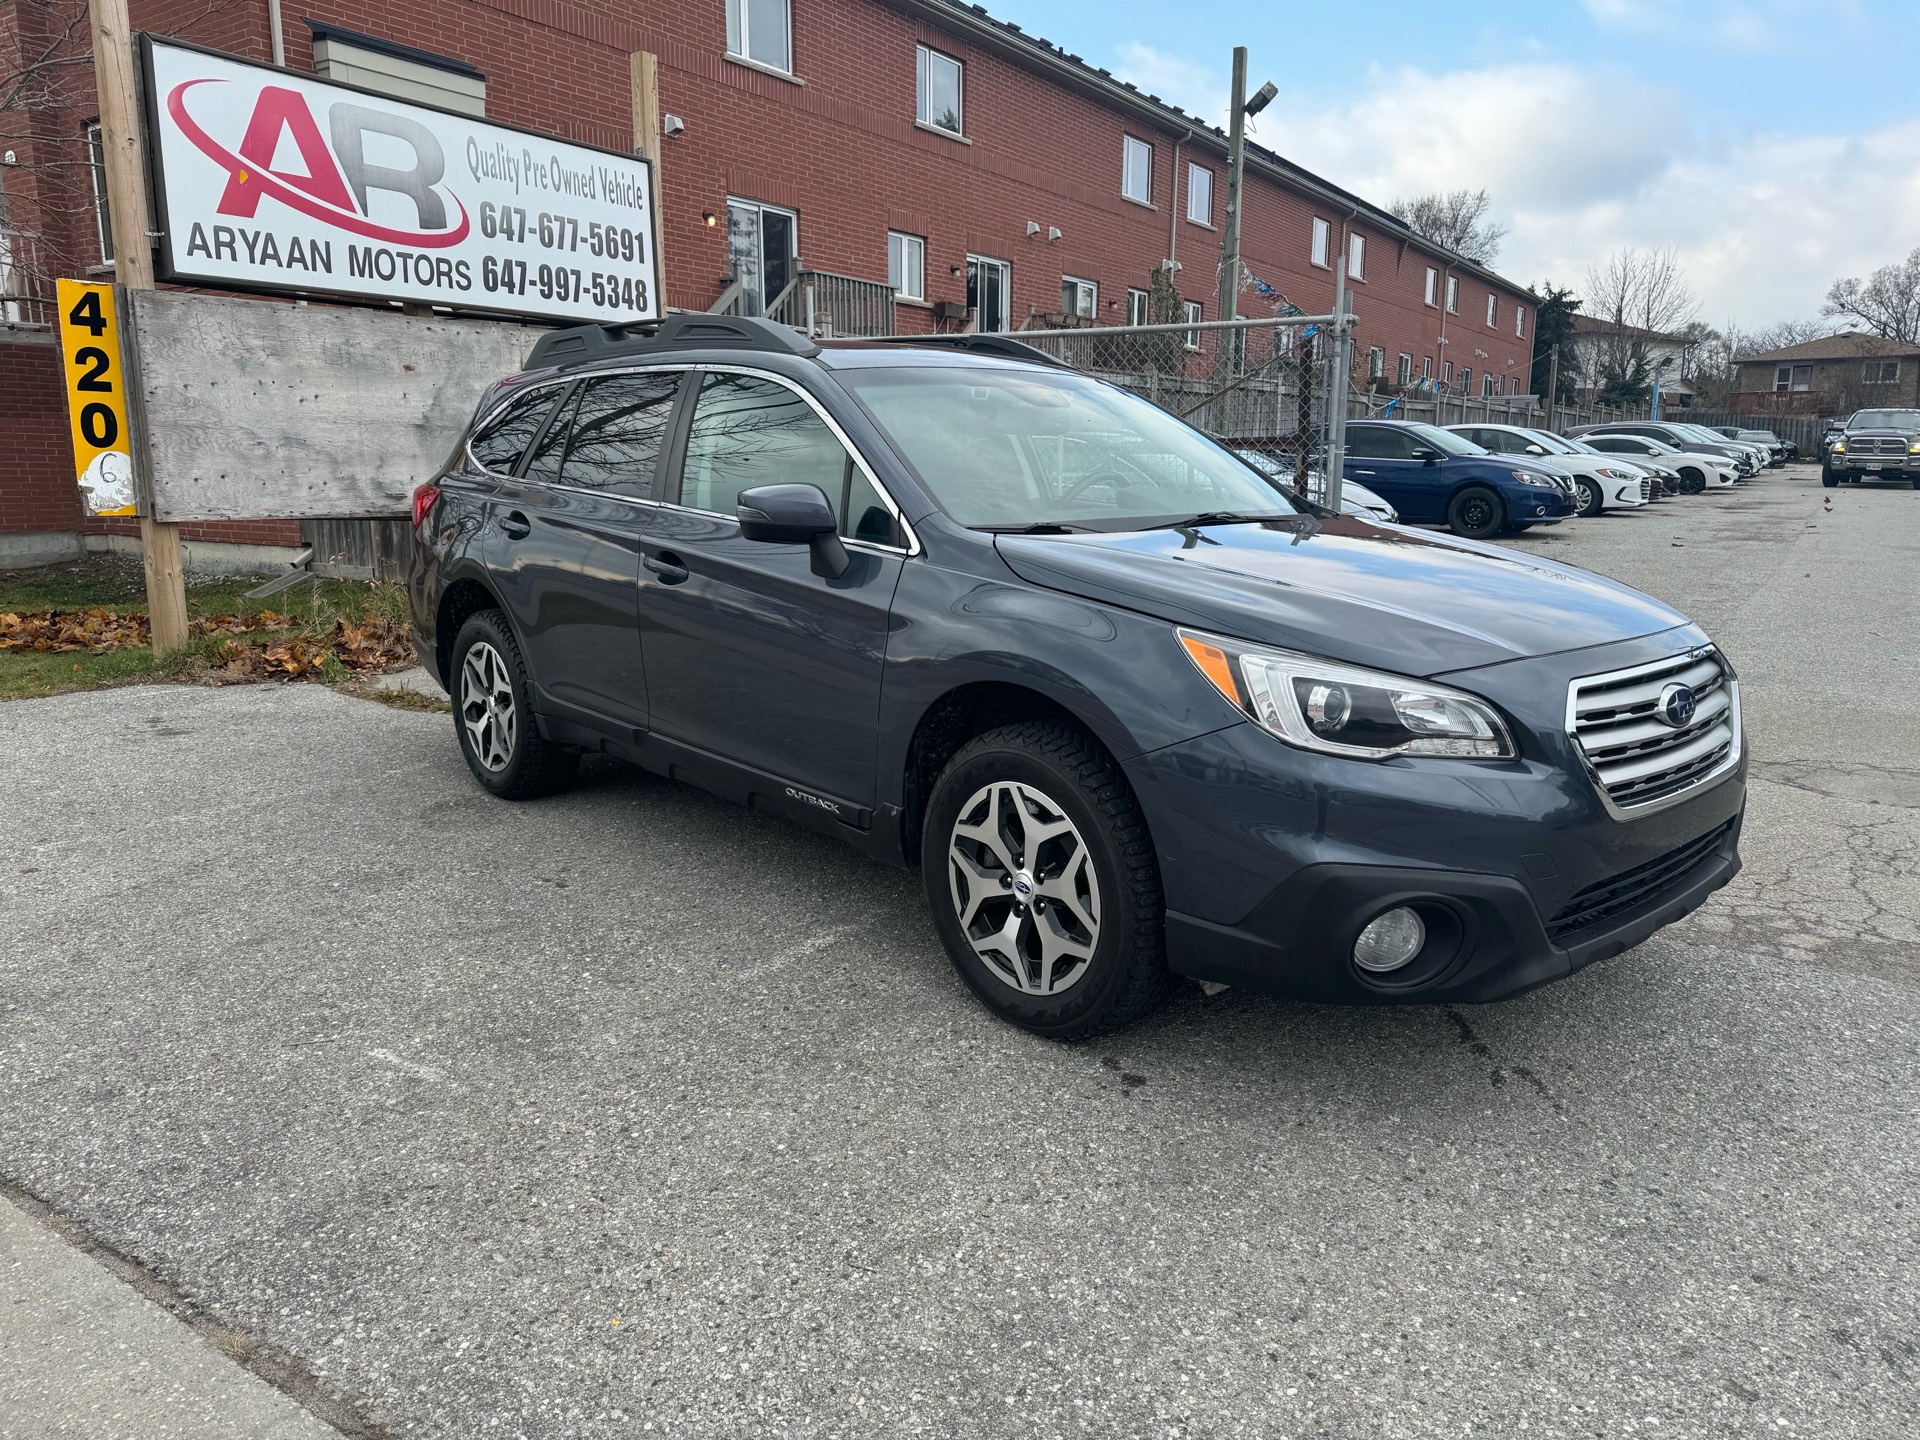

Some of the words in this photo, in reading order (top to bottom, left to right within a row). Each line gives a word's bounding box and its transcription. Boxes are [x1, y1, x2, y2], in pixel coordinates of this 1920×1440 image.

[216, 85, 448, 229] AR
[466, 135, 519, 195] Quality
[522, 148, 548, 189] Pre
[550, 155, 597, 200] Owned
[598, 165, 643, 210] Vehicle
[186, 221, 333, 273] ARYAAN
[348, 244, 472, 291] MOTORS
[479, 200, 645, 264] 647-677-5691
[482, 255, 648, 313] 647-997-5348
[69, 291, 119, 448] 420
[785, 787, 840, 814] OUTBACK
